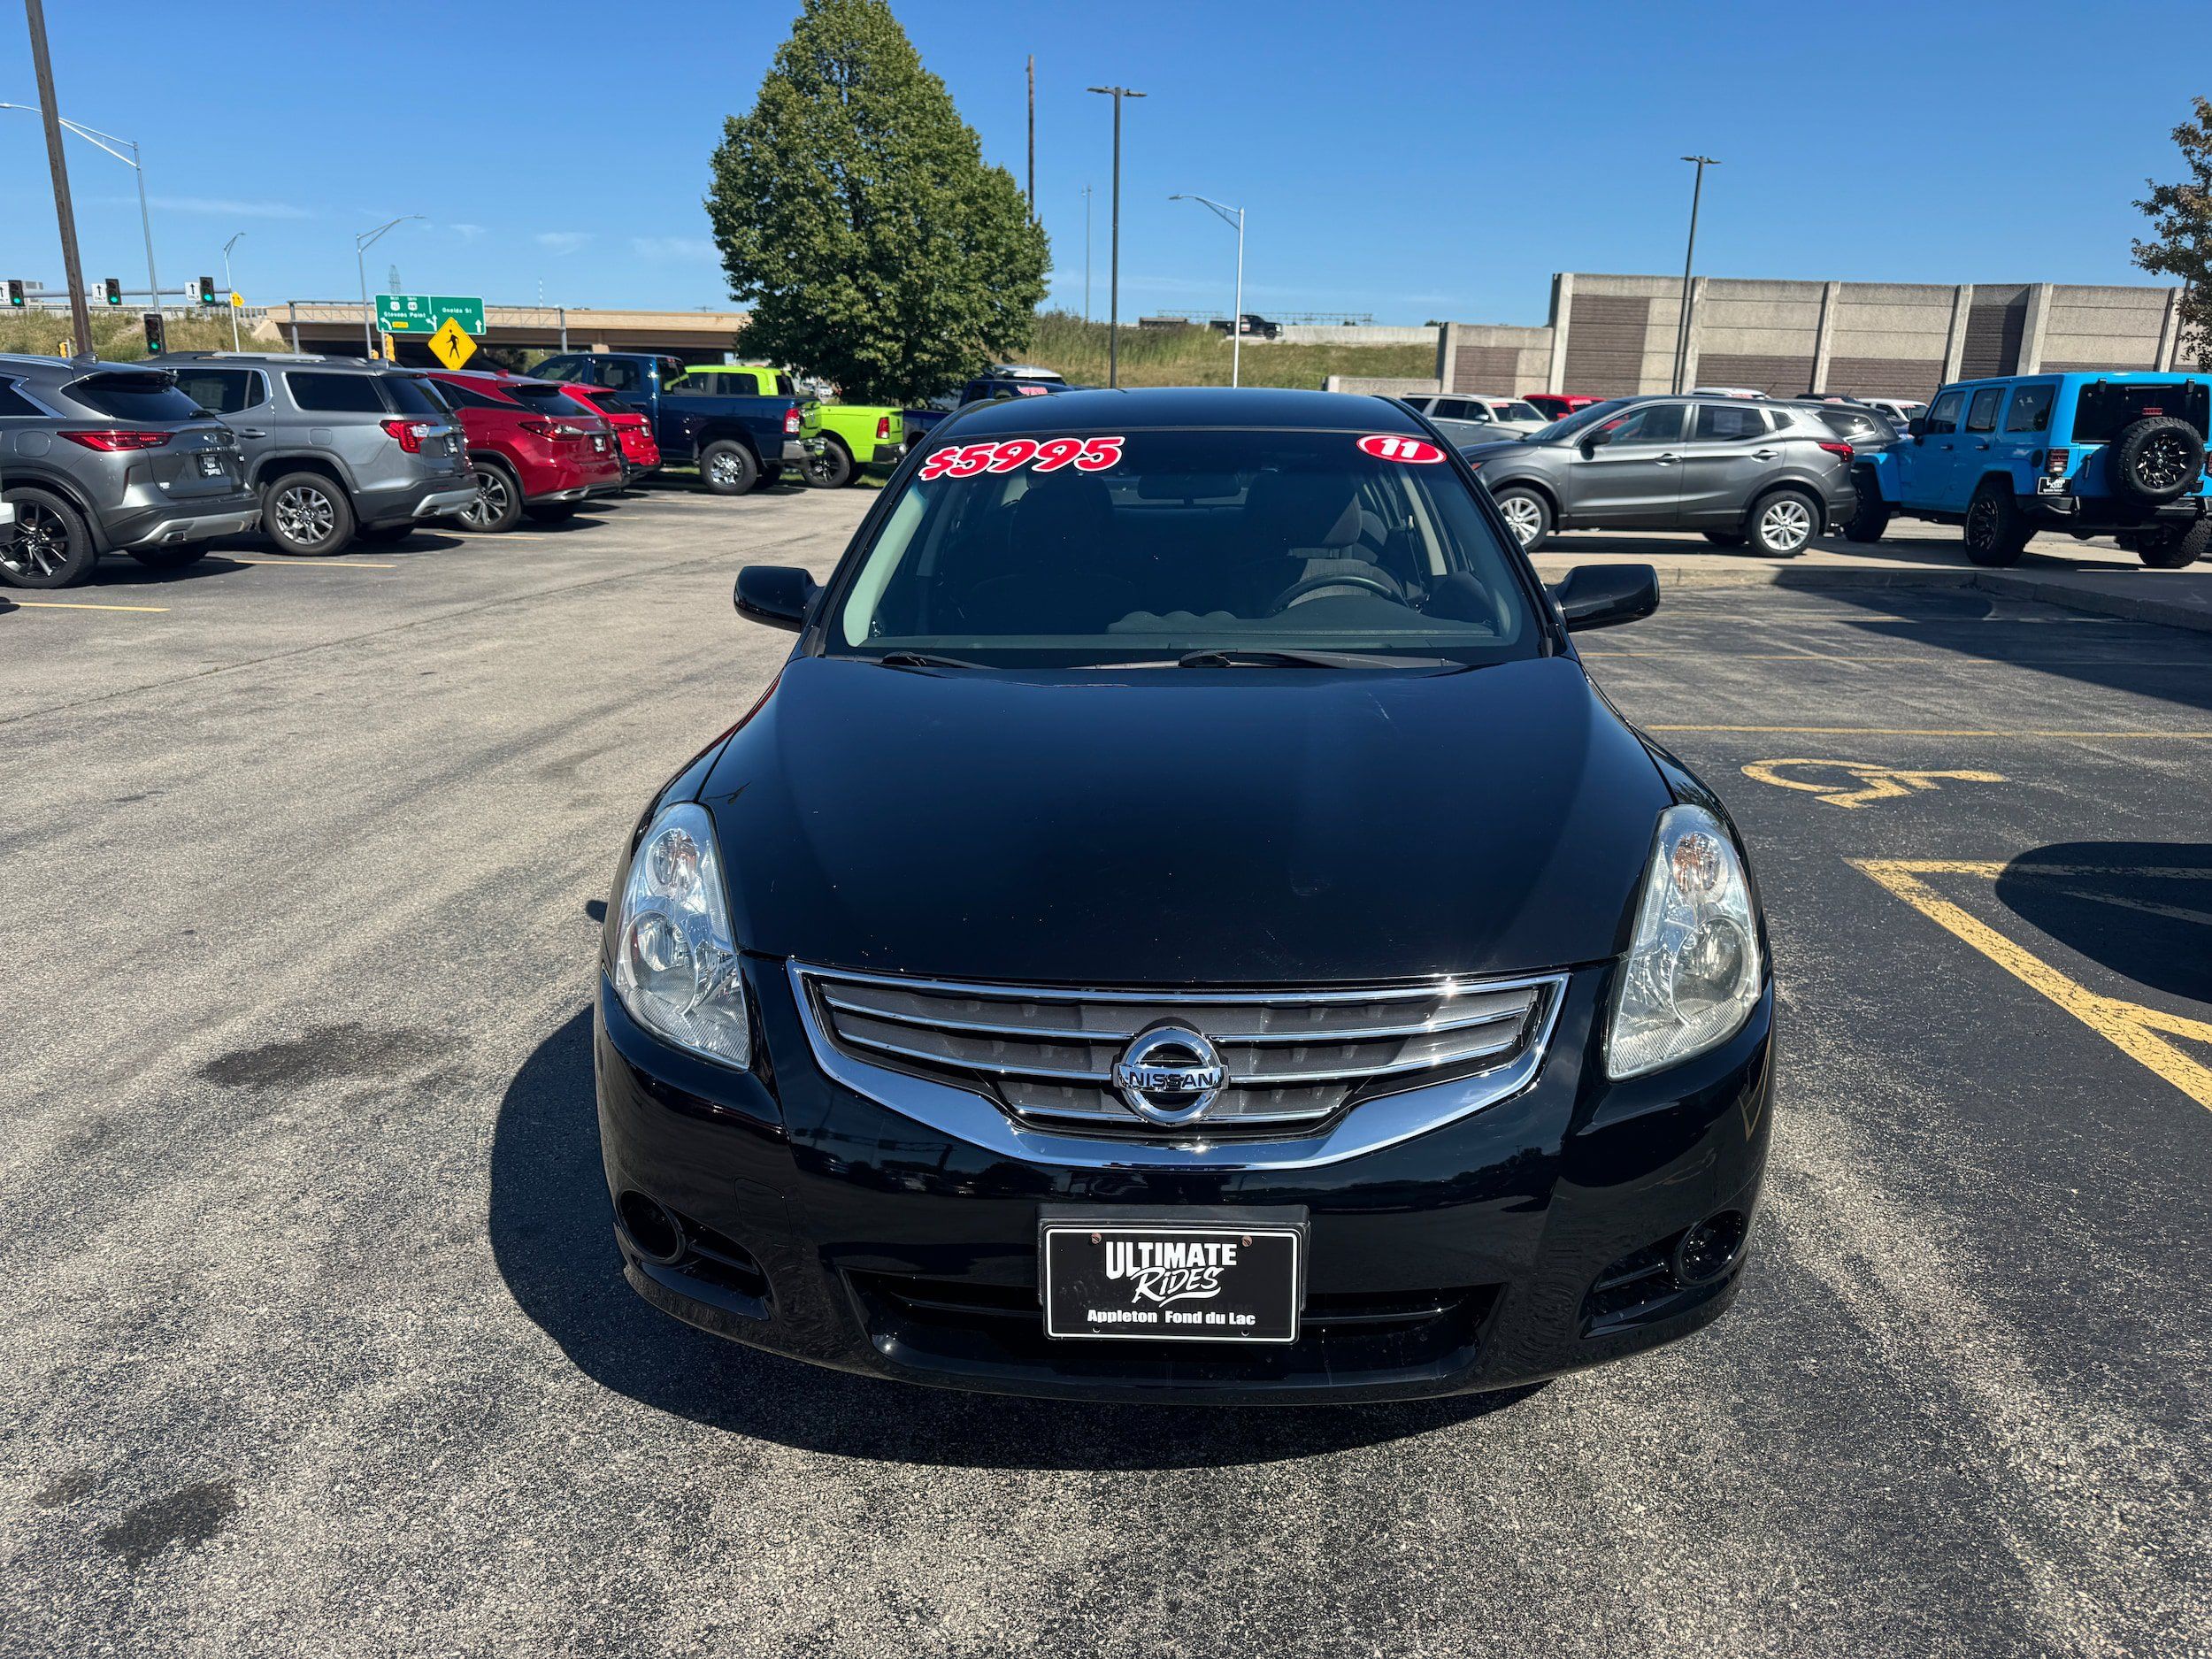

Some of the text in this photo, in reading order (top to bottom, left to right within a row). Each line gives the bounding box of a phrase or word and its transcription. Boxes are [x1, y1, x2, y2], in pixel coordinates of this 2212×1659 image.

[918, 436, 1125, 481] $5995
[1381, 438, 1420, 459] 11
[1129, 1071, 1213, 1089] NISSAN
[1104, 1240, 1238, 1280] ULTIMATE
[1087, 1309, 1256, 1325] Appleton Fond du Lac
